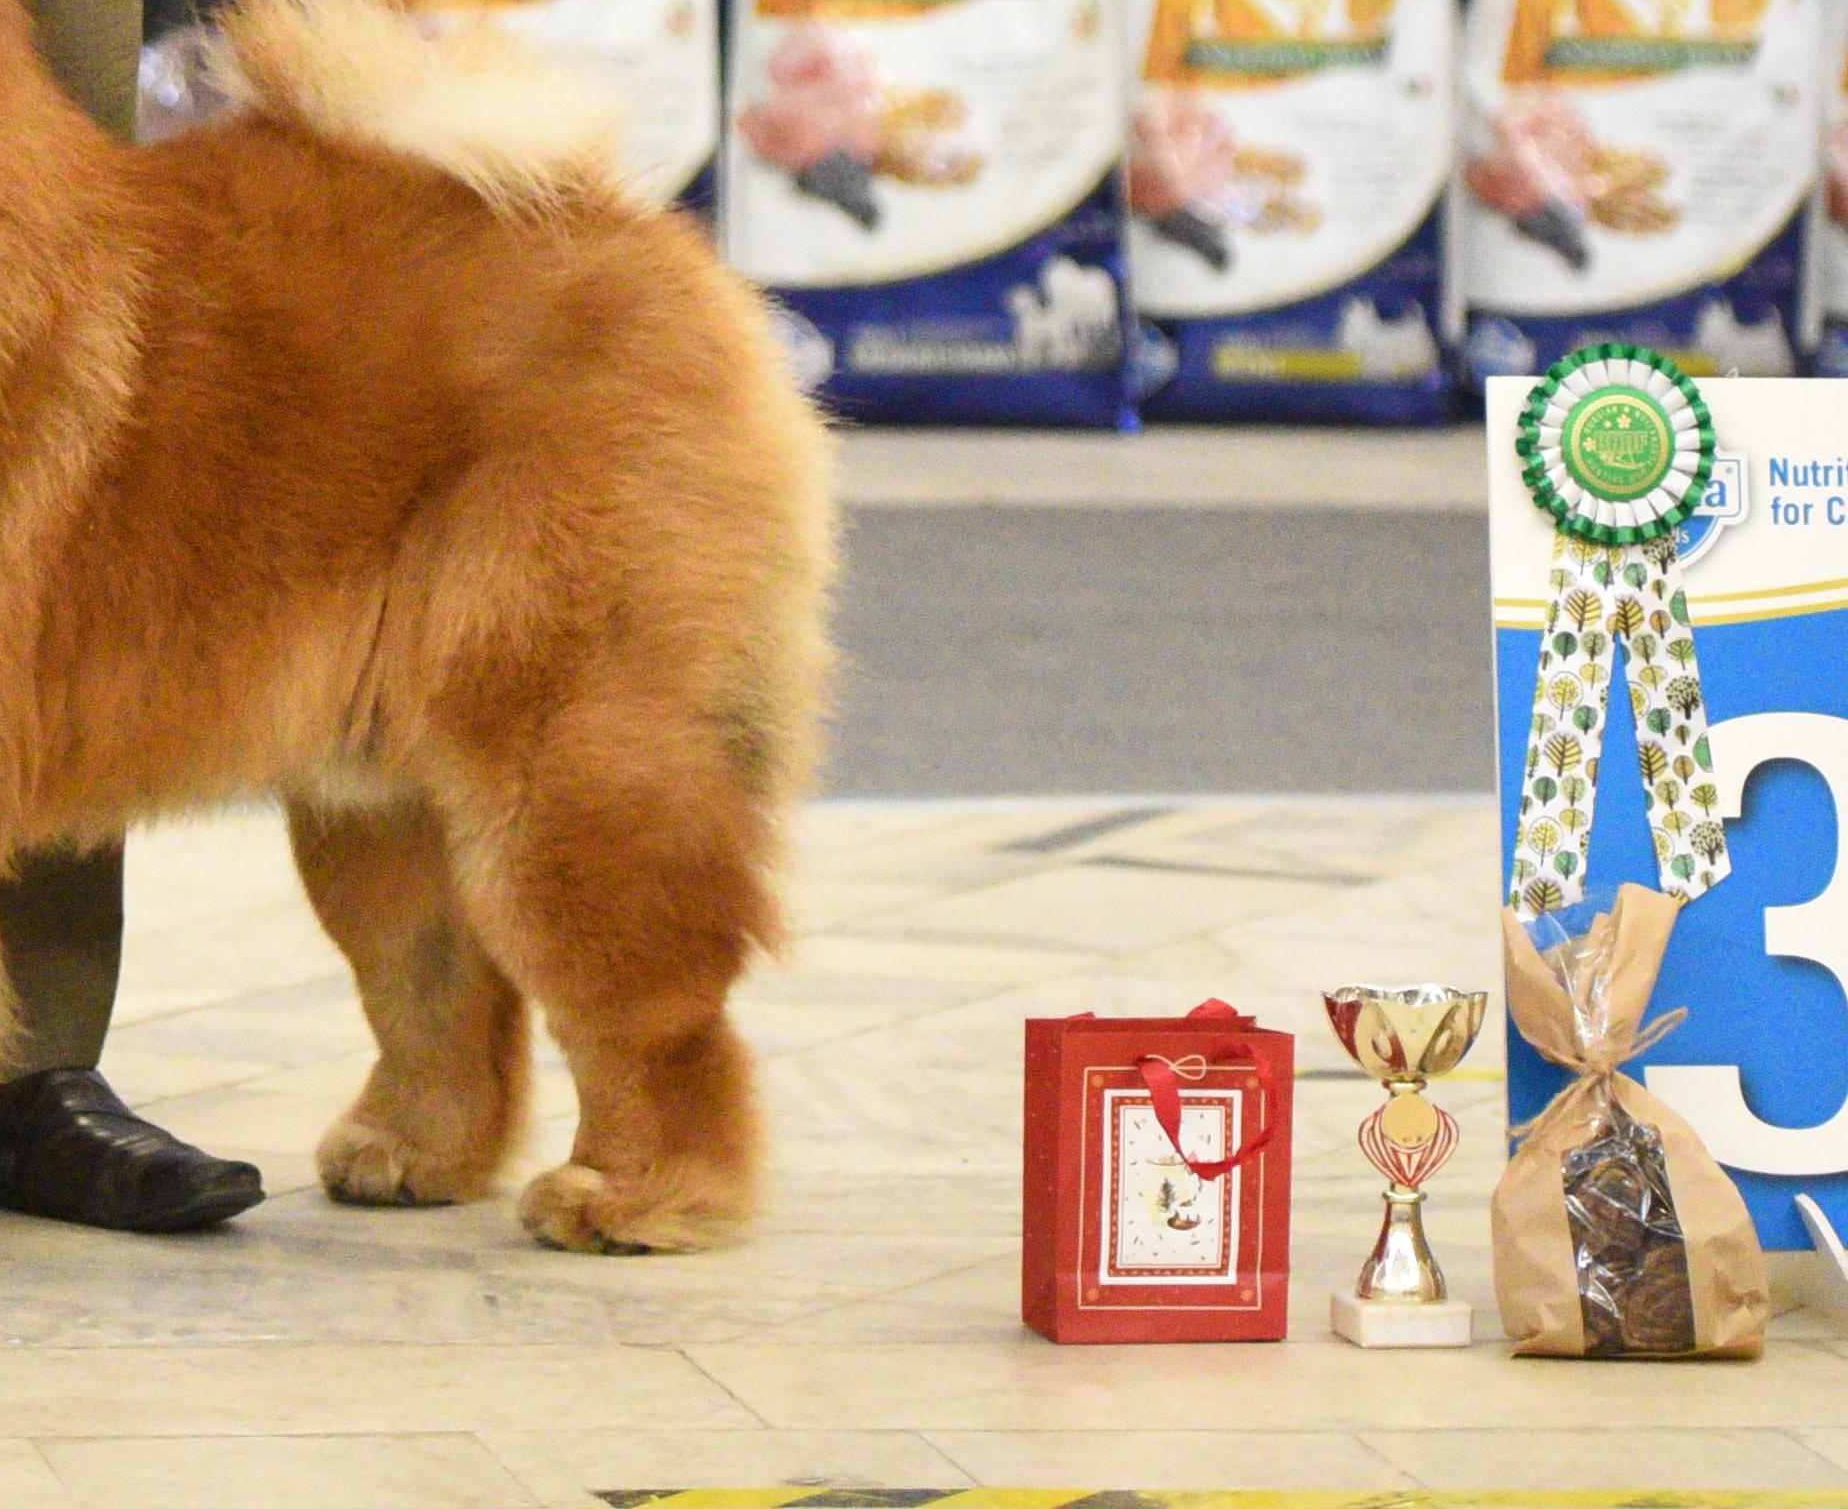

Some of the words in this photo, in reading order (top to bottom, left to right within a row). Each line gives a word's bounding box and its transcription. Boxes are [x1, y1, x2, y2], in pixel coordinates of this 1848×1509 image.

[1768, 456, 1848, 488] Nutri
[1770, 495, 1815, 526] for
[1642, 711, 1848, 1175] 3
